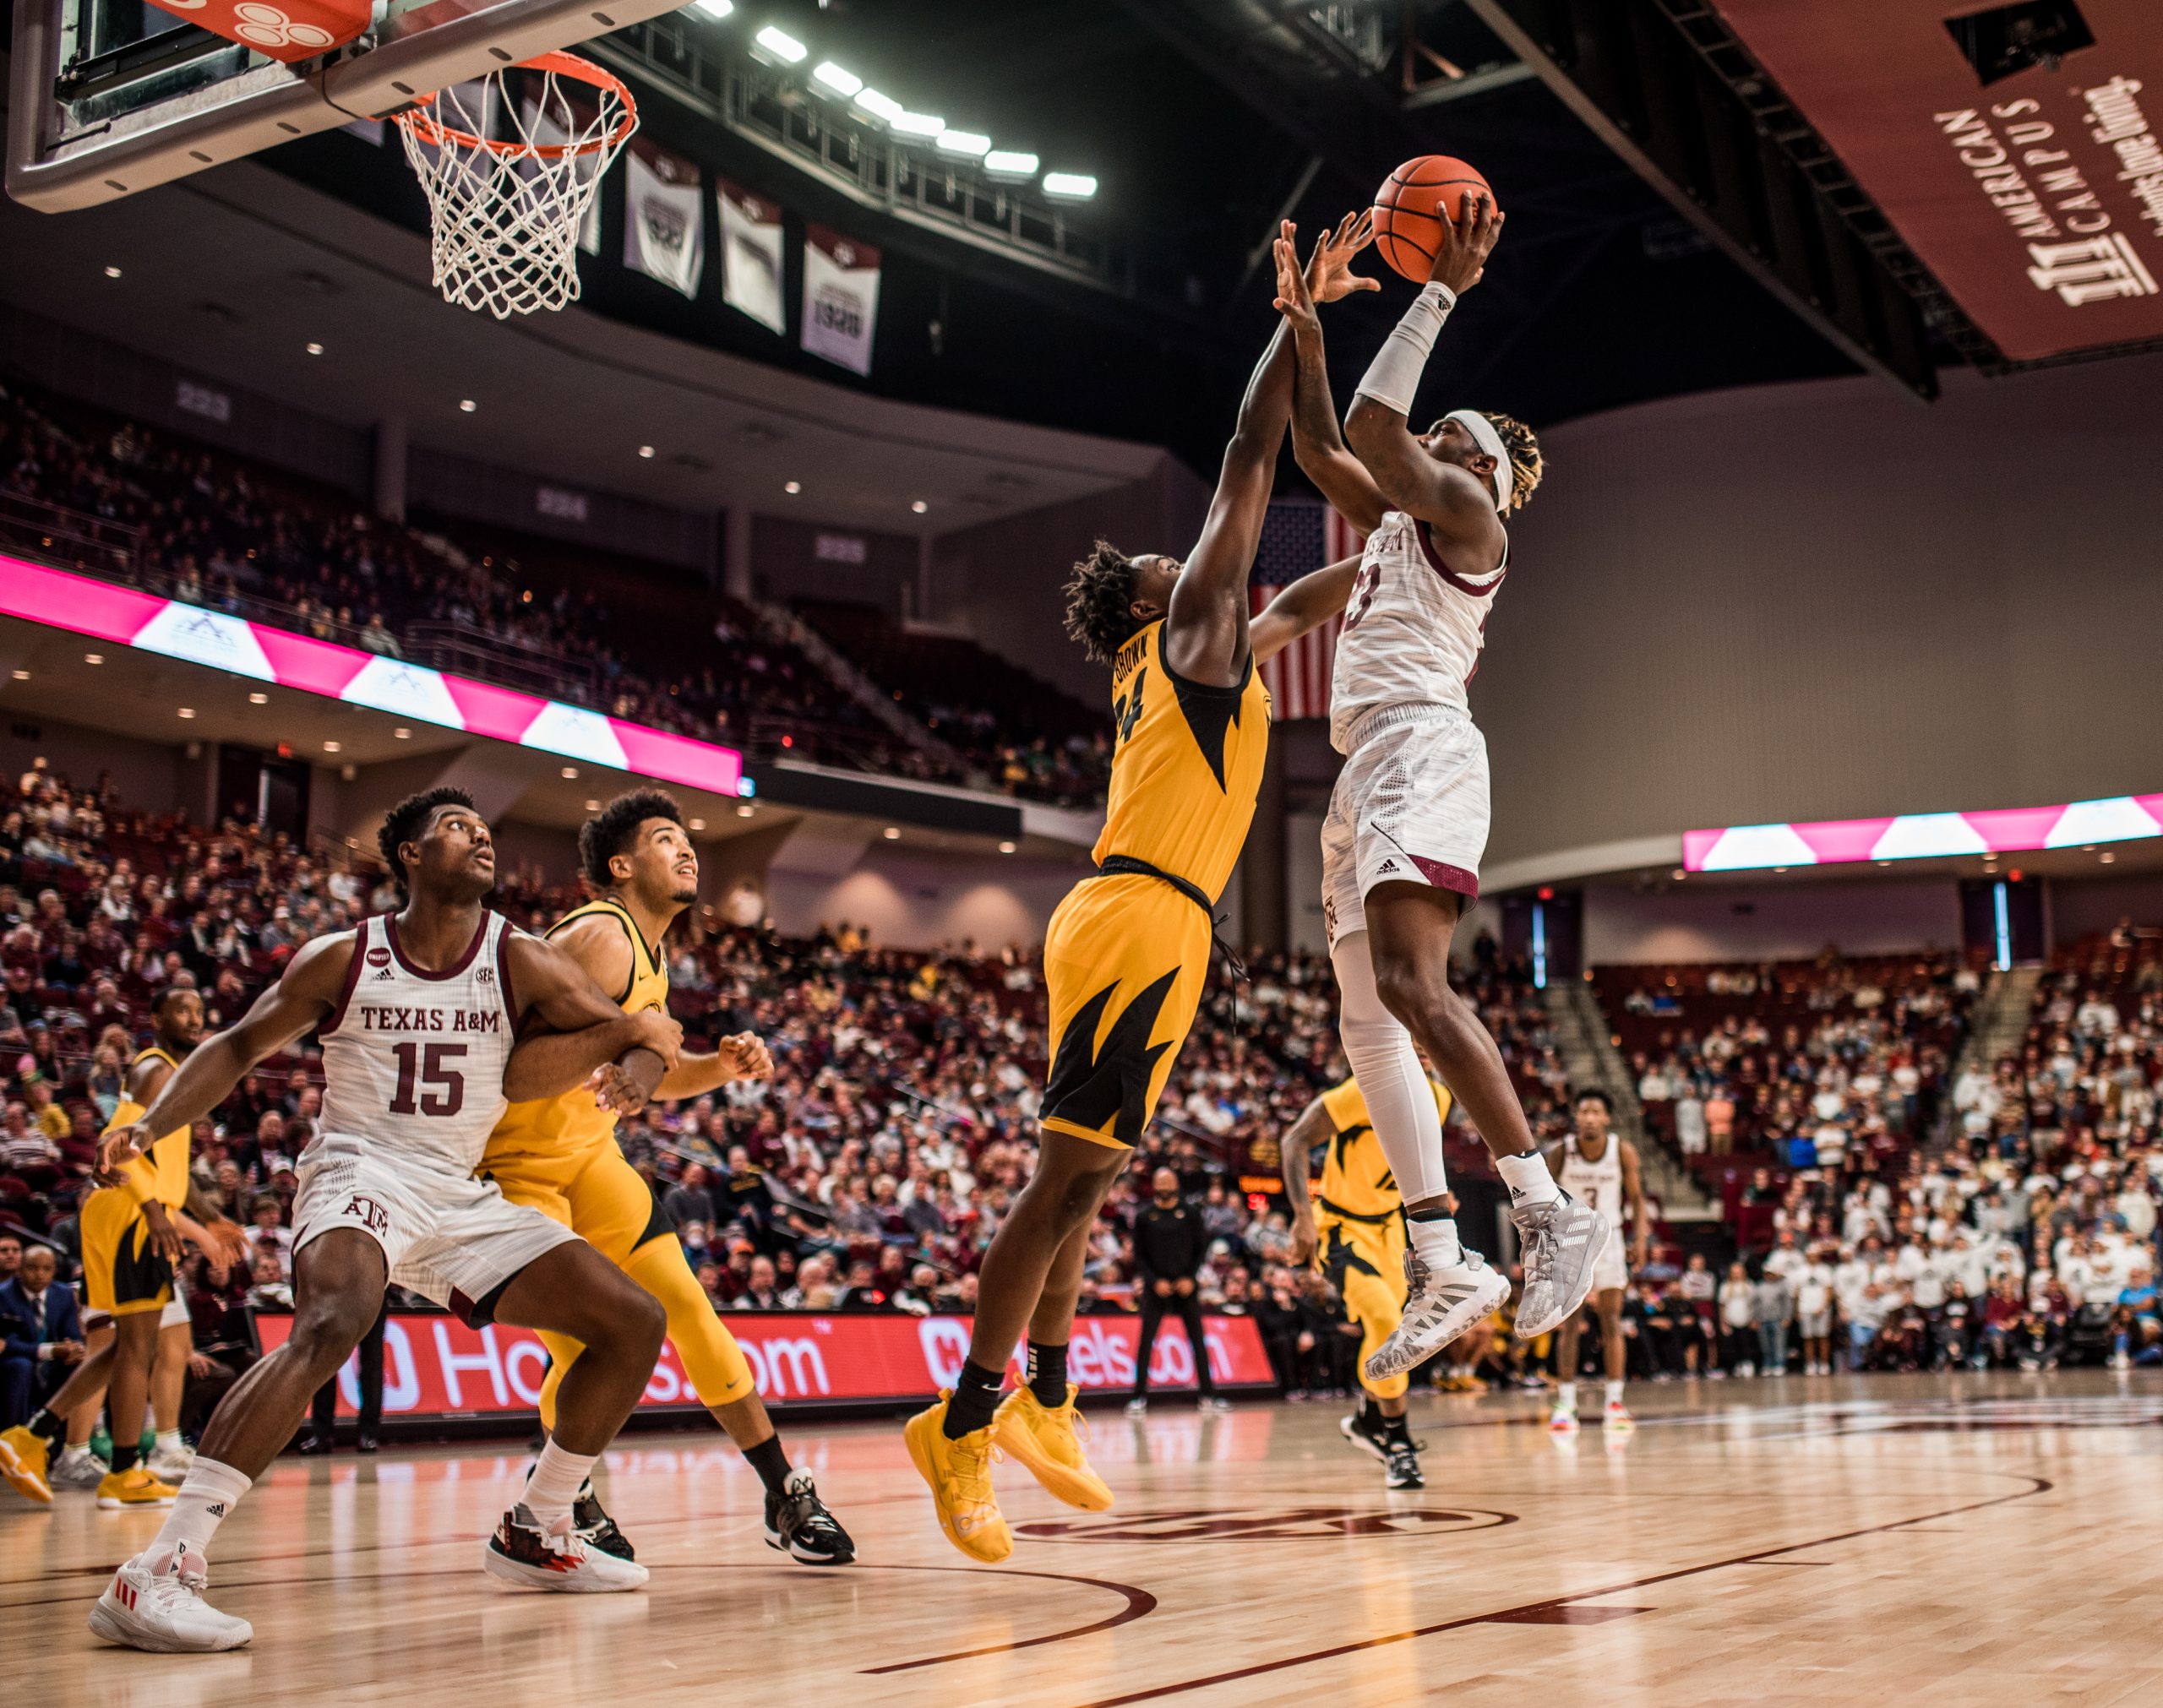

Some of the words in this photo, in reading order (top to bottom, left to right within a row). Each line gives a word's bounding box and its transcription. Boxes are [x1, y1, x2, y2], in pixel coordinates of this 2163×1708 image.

[1933, 108, 2061, 238] AMERICAN
[1991, 98, 2111, 234] CAMPUS
[1376, 866, 1400, 876] adidas
[361, 1006, 444, 1031] TEXAS
[453, 1009, 502, 1032] A&M
[390, 1042, 467, 1116] 15
